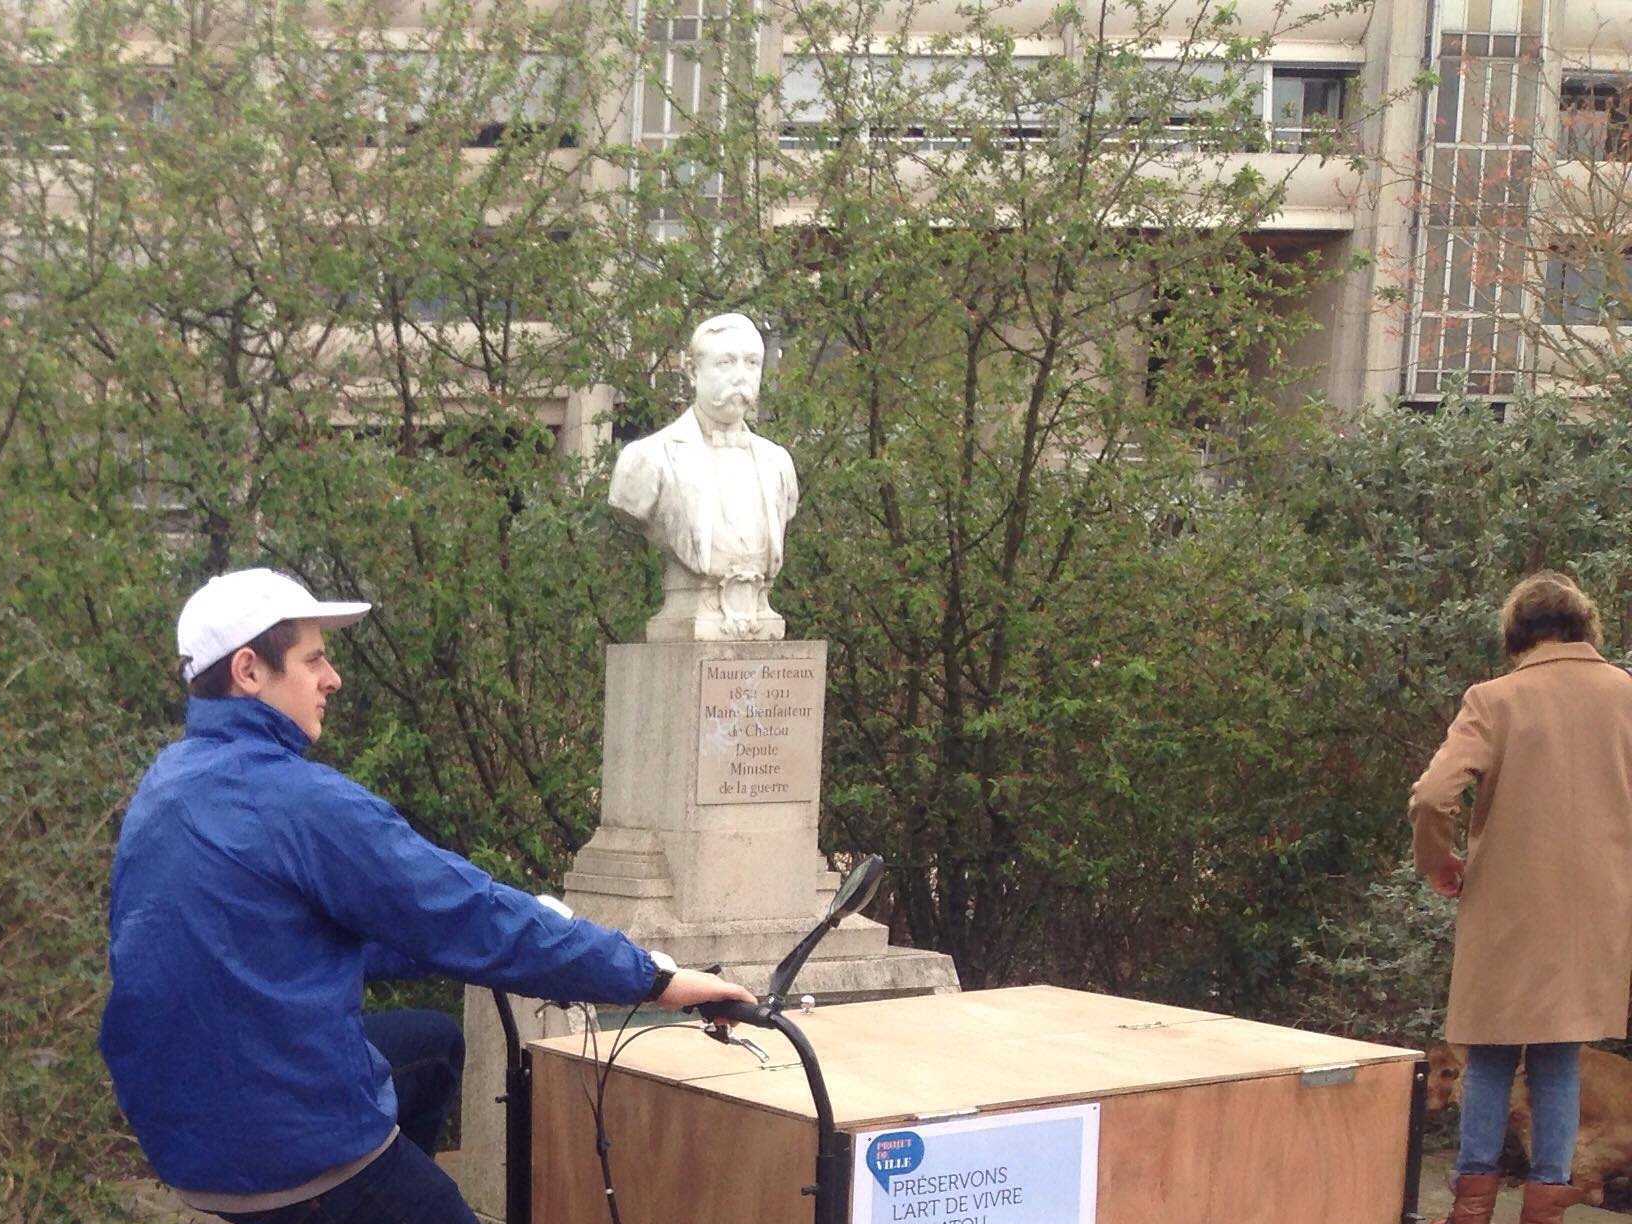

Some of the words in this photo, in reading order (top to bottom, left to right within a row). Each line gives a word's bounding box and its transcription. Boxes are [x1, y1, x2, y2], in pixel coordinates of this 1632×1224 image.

[707, 666, 756, 680] Maurice
[762, 665, 815, 679] Berteaux
[746, 705, 813, 719] Bienfaiteur
[745, 723, 789, 737] Chatou
[730, 762, 781, 776] Ministre
[719, 781, 734, 794] de
[736, 780, 747, 794] la
[750, 783, 789, 798] guerre
[876, 1156, 912, 1170] VILLE
[893, 1166, 1008, 1197] PRÉSERVONS
[893, 1199, 942, 1221] L'ART
[945, 1195, 968, 1215] DE
[973, 1187, 1023, 1209] VIVRE
